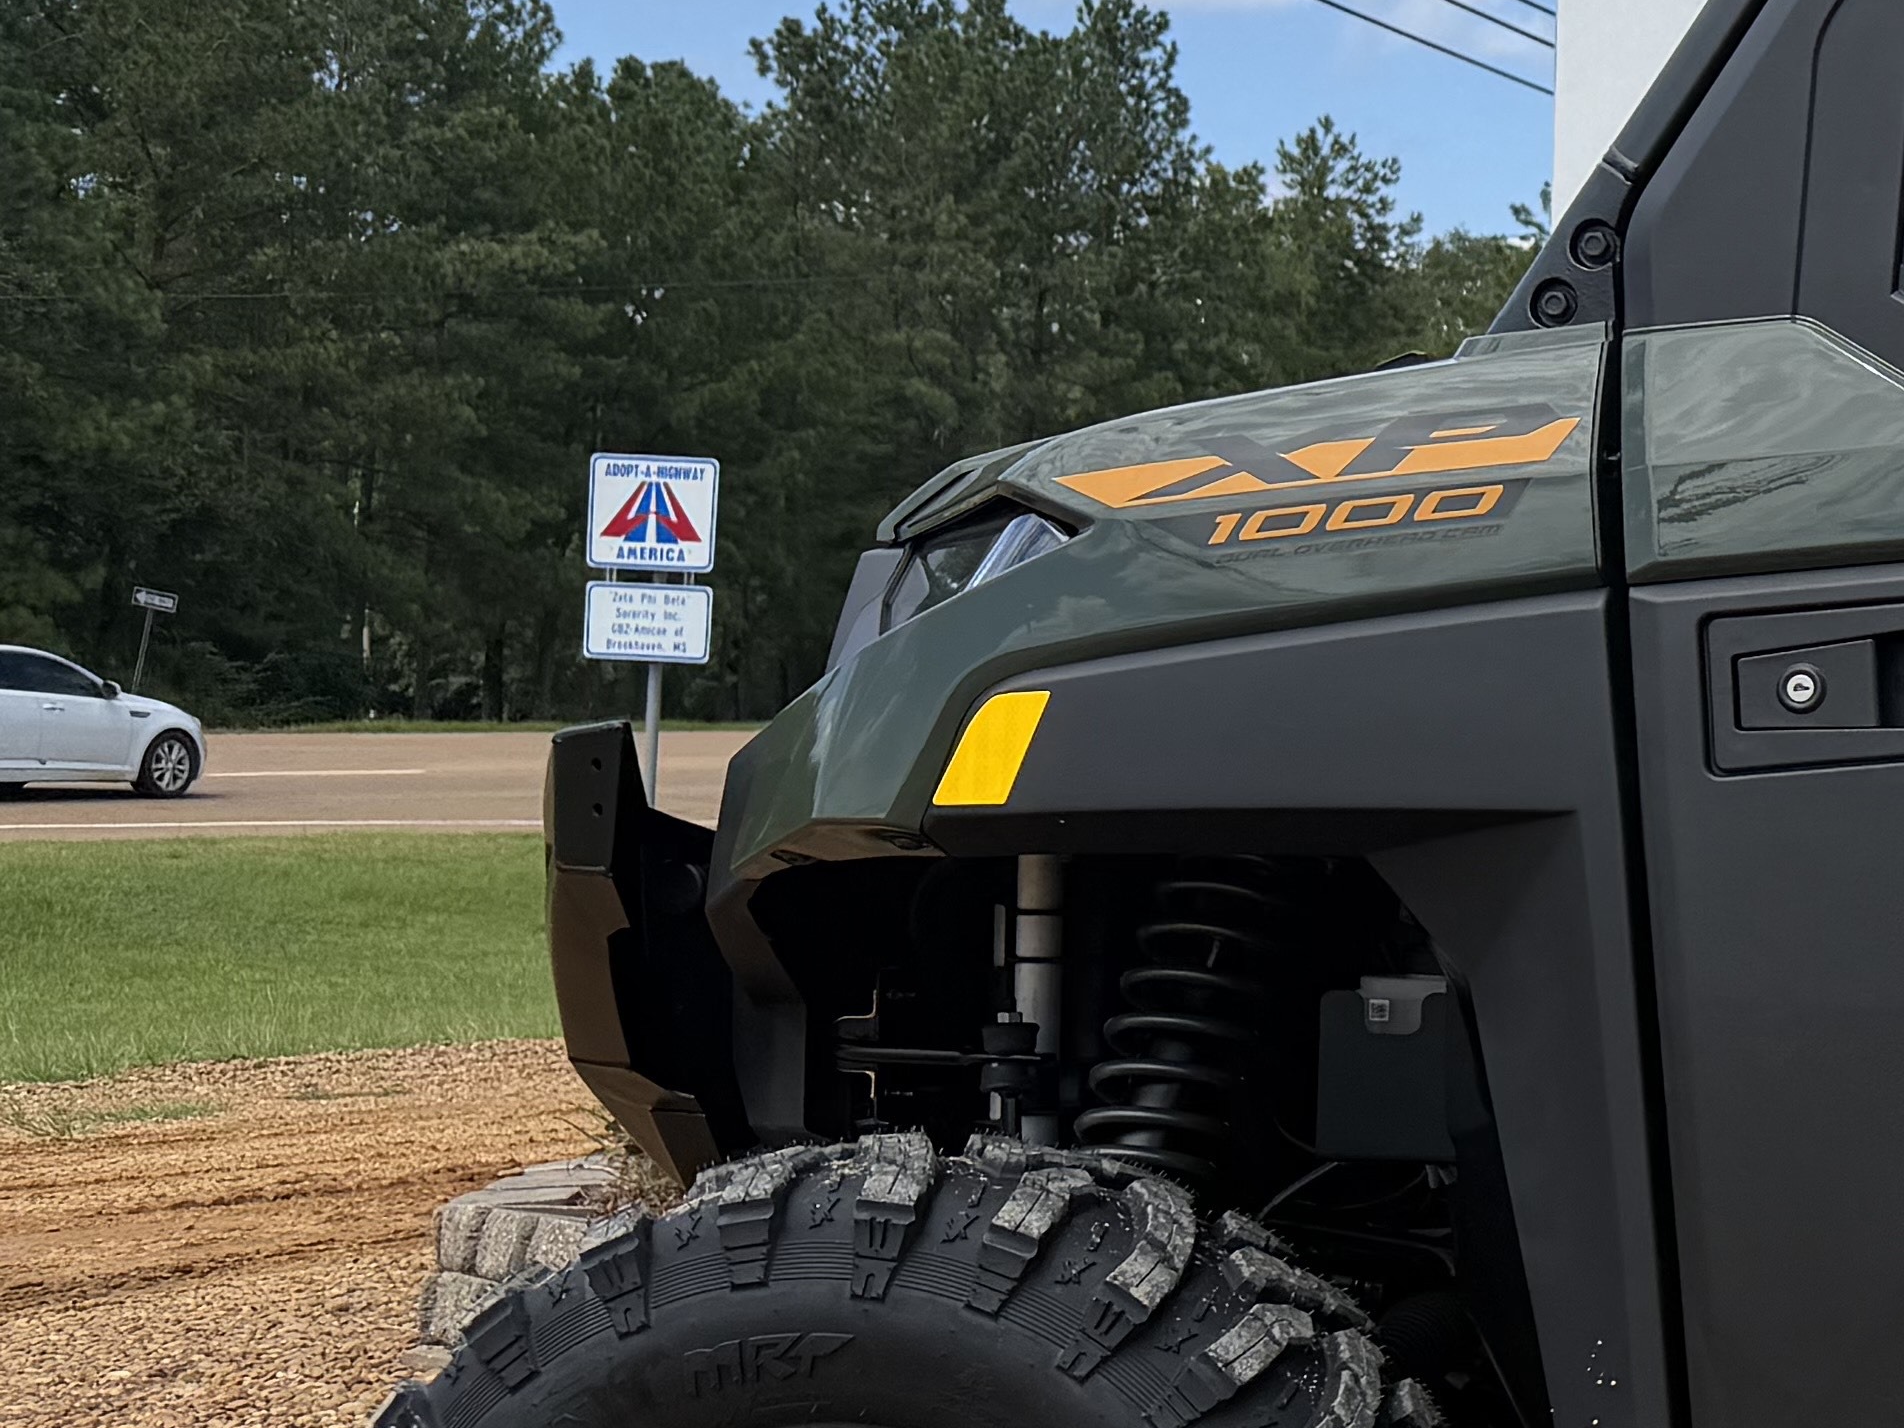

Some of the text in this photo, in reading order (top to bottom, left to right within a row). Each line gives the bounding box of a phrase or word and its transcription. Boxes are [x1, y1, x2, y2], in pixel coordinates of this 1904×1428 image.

[1208, 484, 1504, 546] 1000
[616, 546, 686, 562] AMERICA
[1292, 530, 1439, 557] OVERHEAD
[1440, 522, 1504, 542] CAM
